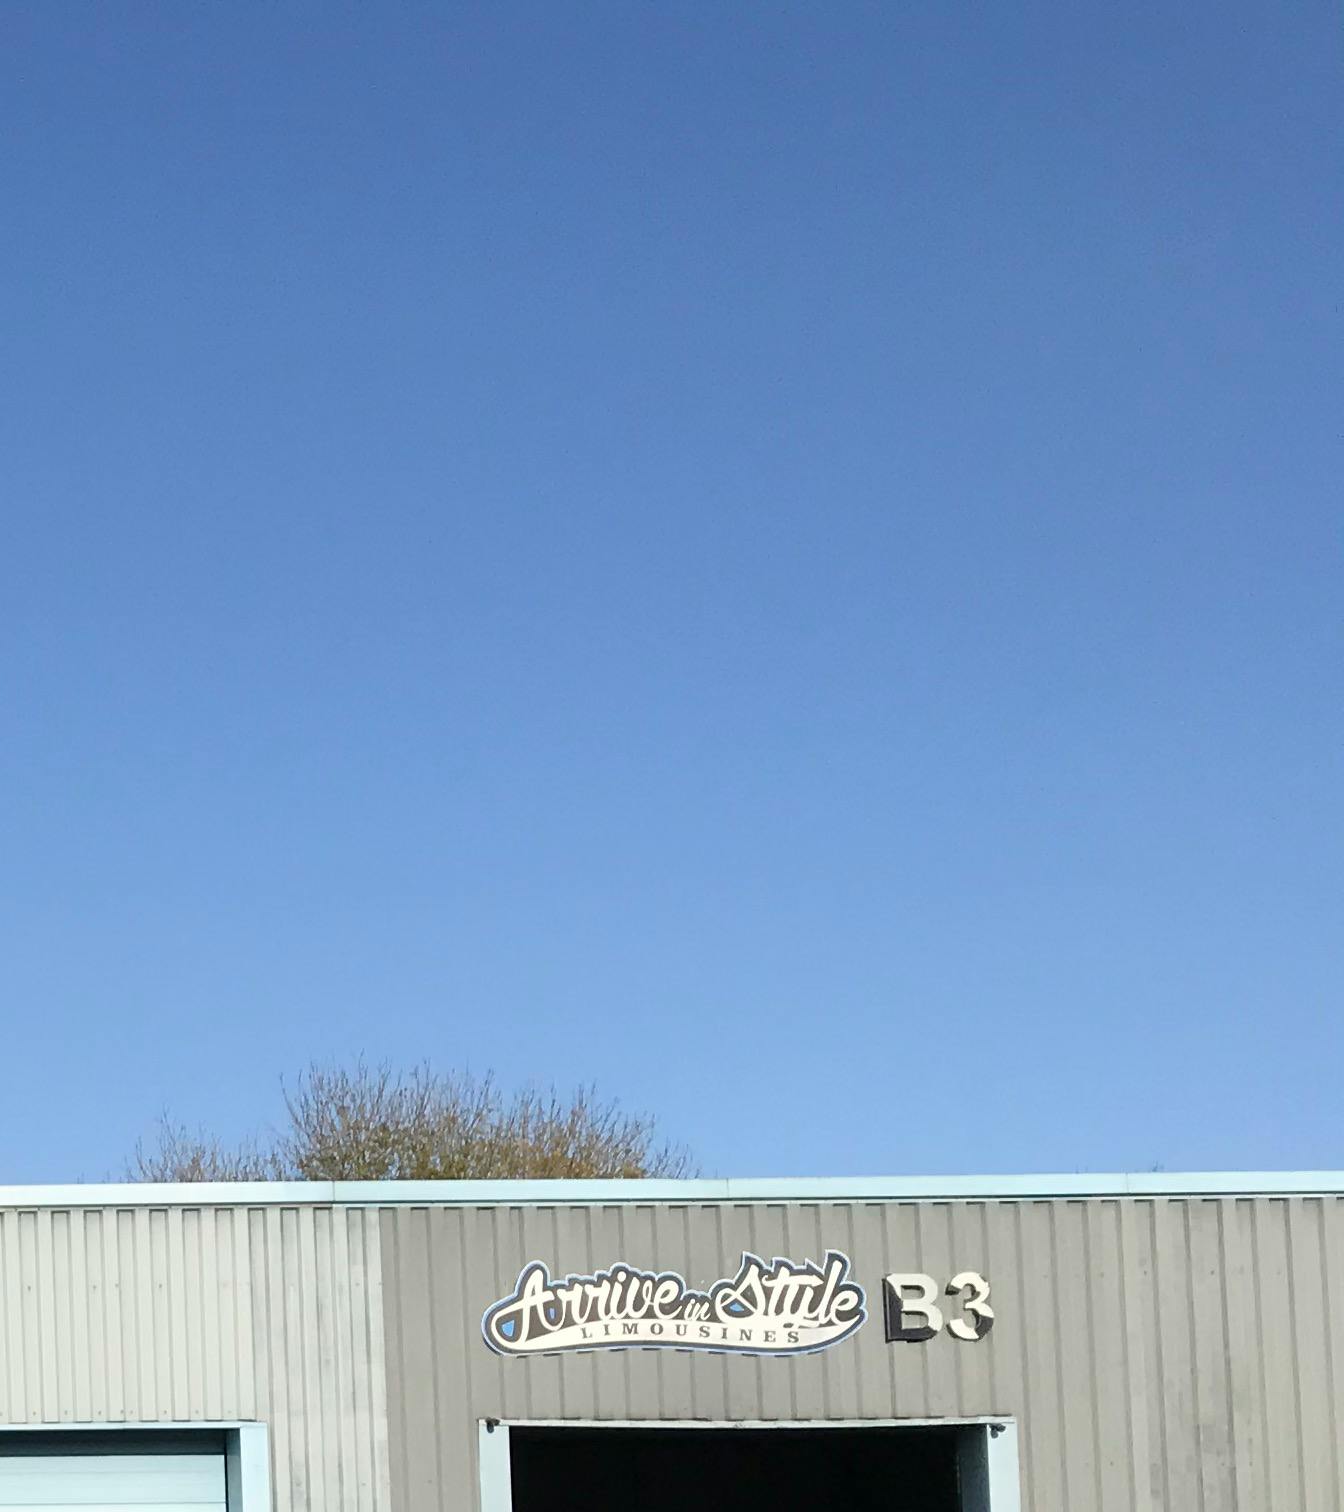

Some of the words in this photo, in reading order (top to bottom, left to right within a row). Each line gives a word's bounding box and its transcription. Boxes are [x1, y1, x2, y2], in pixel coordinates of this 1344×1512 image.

[491, 1269, 683, 1346] Arrive
[683, 1298, 712, 1322] in
[715, 1259, 860, 1331] Style
[581, 1322, 800, 1344] LIMOUSINES
[882, 1271, 995, 1343] B3
